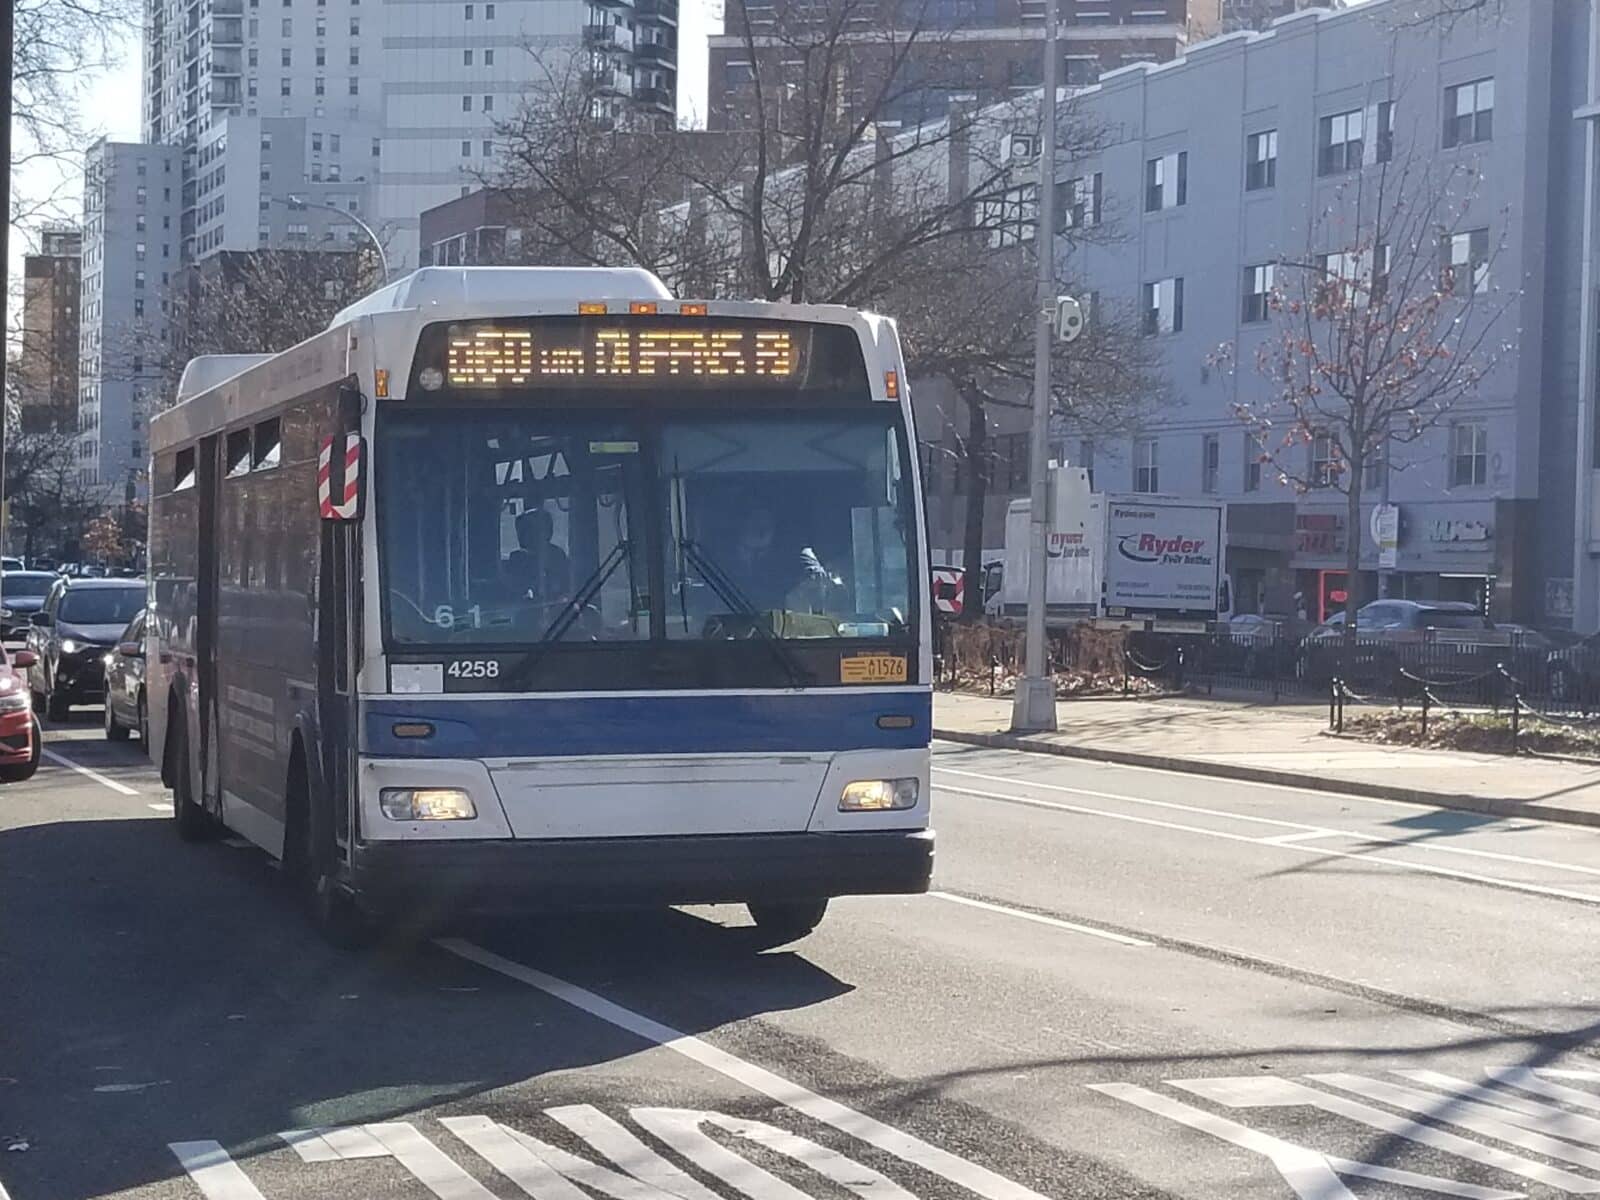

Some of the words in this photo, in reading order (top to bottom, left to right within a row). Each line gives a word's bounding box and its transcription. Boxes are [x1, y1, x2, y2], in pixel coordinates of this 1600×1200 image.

[1138, 533, 1204, 555] Ryder
[448, 660, 499, 678] 4258
[1085, 1066, 1600, 1200] NLY
